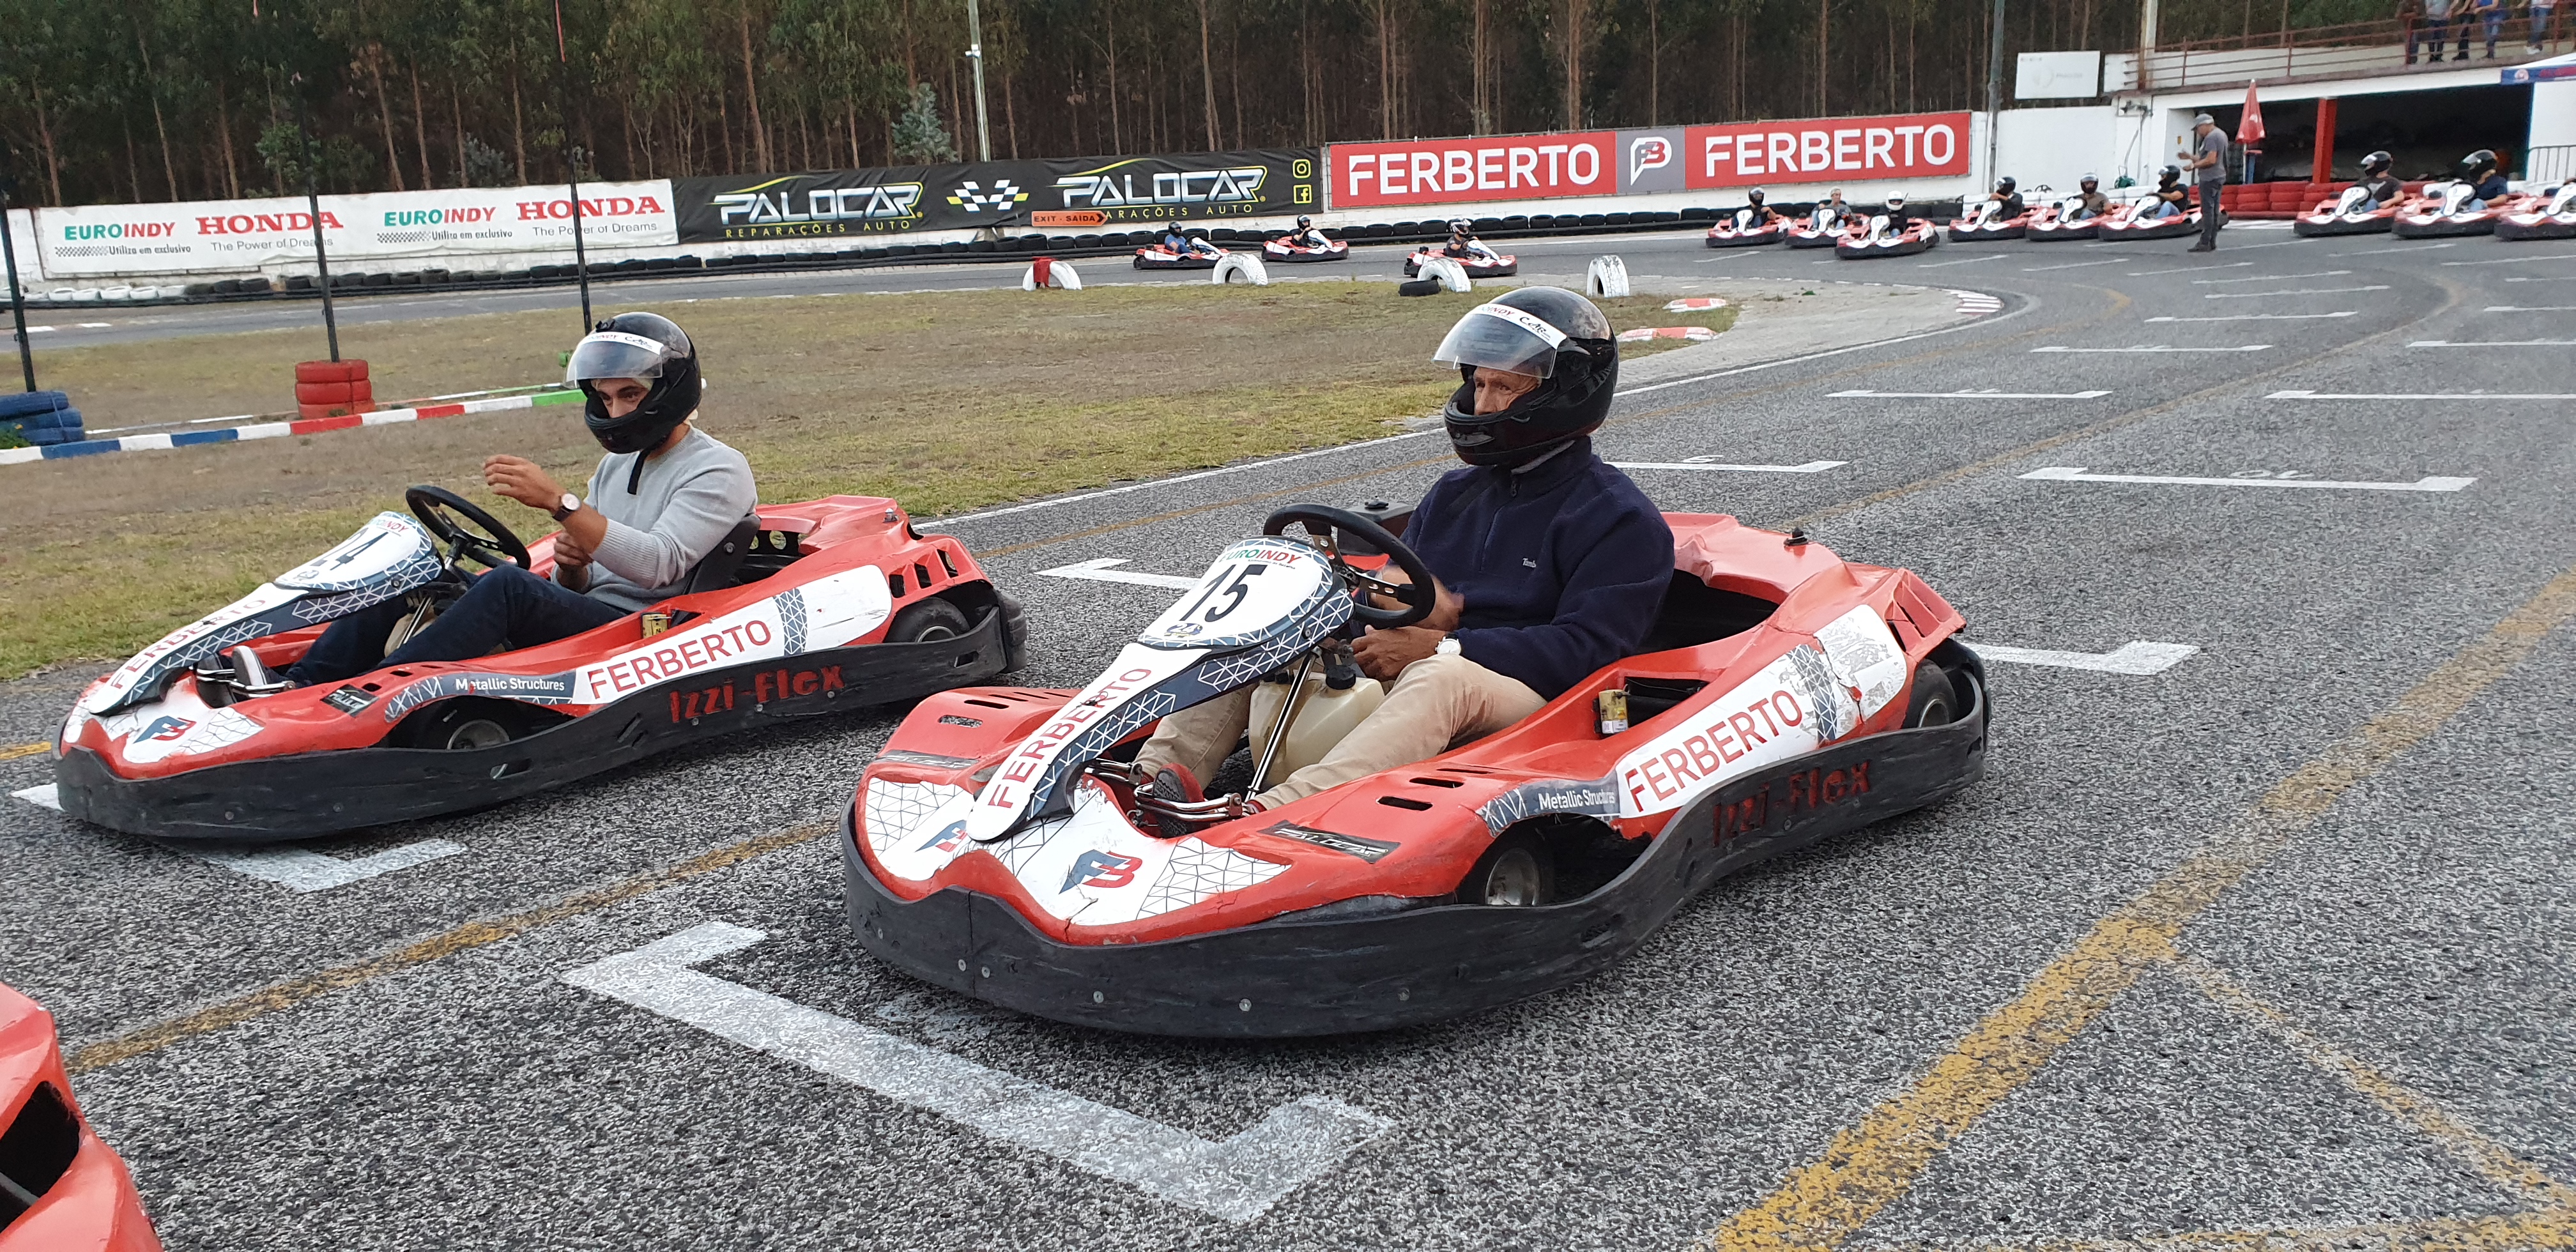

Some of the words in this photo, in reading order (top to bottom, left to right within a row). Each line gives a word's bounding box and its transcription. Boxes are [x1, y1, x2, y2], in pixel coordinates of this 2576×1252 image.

[1706, 125, 1955, 178] FERBERTO
[1349, 143, 1600, 195] FERBERTO
[1056, 168, 1265, 208] PALOCAR
[516, 195, 666, 220] HONDA
[714, 185, 920, 225] PALOCAR
[1106, 206, 1188, 219] ARAÇÕES
[1206, 204, 1253, 215] AUTO
[195, 211, 344, 235] HONDA
[384, 206, 496, 227] EUROINDY
[65, 222, 176, 241] EUROINDY
[431, 229, 458, 241] Utiliza
[460, 231, 473, 240] em
[475, 228, 512, 240] exclusivo
[532, 227, 555, 236] The
[558, 225, 594, 236] Poer
[598, 224, 608, 234] of
[611, 222, 657, 233] Dreams
[725, 223, 846, 238] REPARAÇÕES
[863, 220, 910, 232] AUTO
[109, 245, 137, 256] Utiliza
[155, 243, 191, 254] exclusivo
[211, 241, 234, 252] The
[237, 240, 272, 250] Power
[276, 238, 287, 248] of
[1218, 549, 1303, 564] EUROINDY
[1178, 563, 1268, 623] 15
[110, 597, 266, 690] FERBERTO
[587, 620, 772, 699] FERBERTO
[510, 677, 565, 691] Structures
[987, 668, 1153, 810] FERBERTO
[1625, 690, 1803, 813] FERBERTO
[1538, 791, 1583, 810] Metallic
